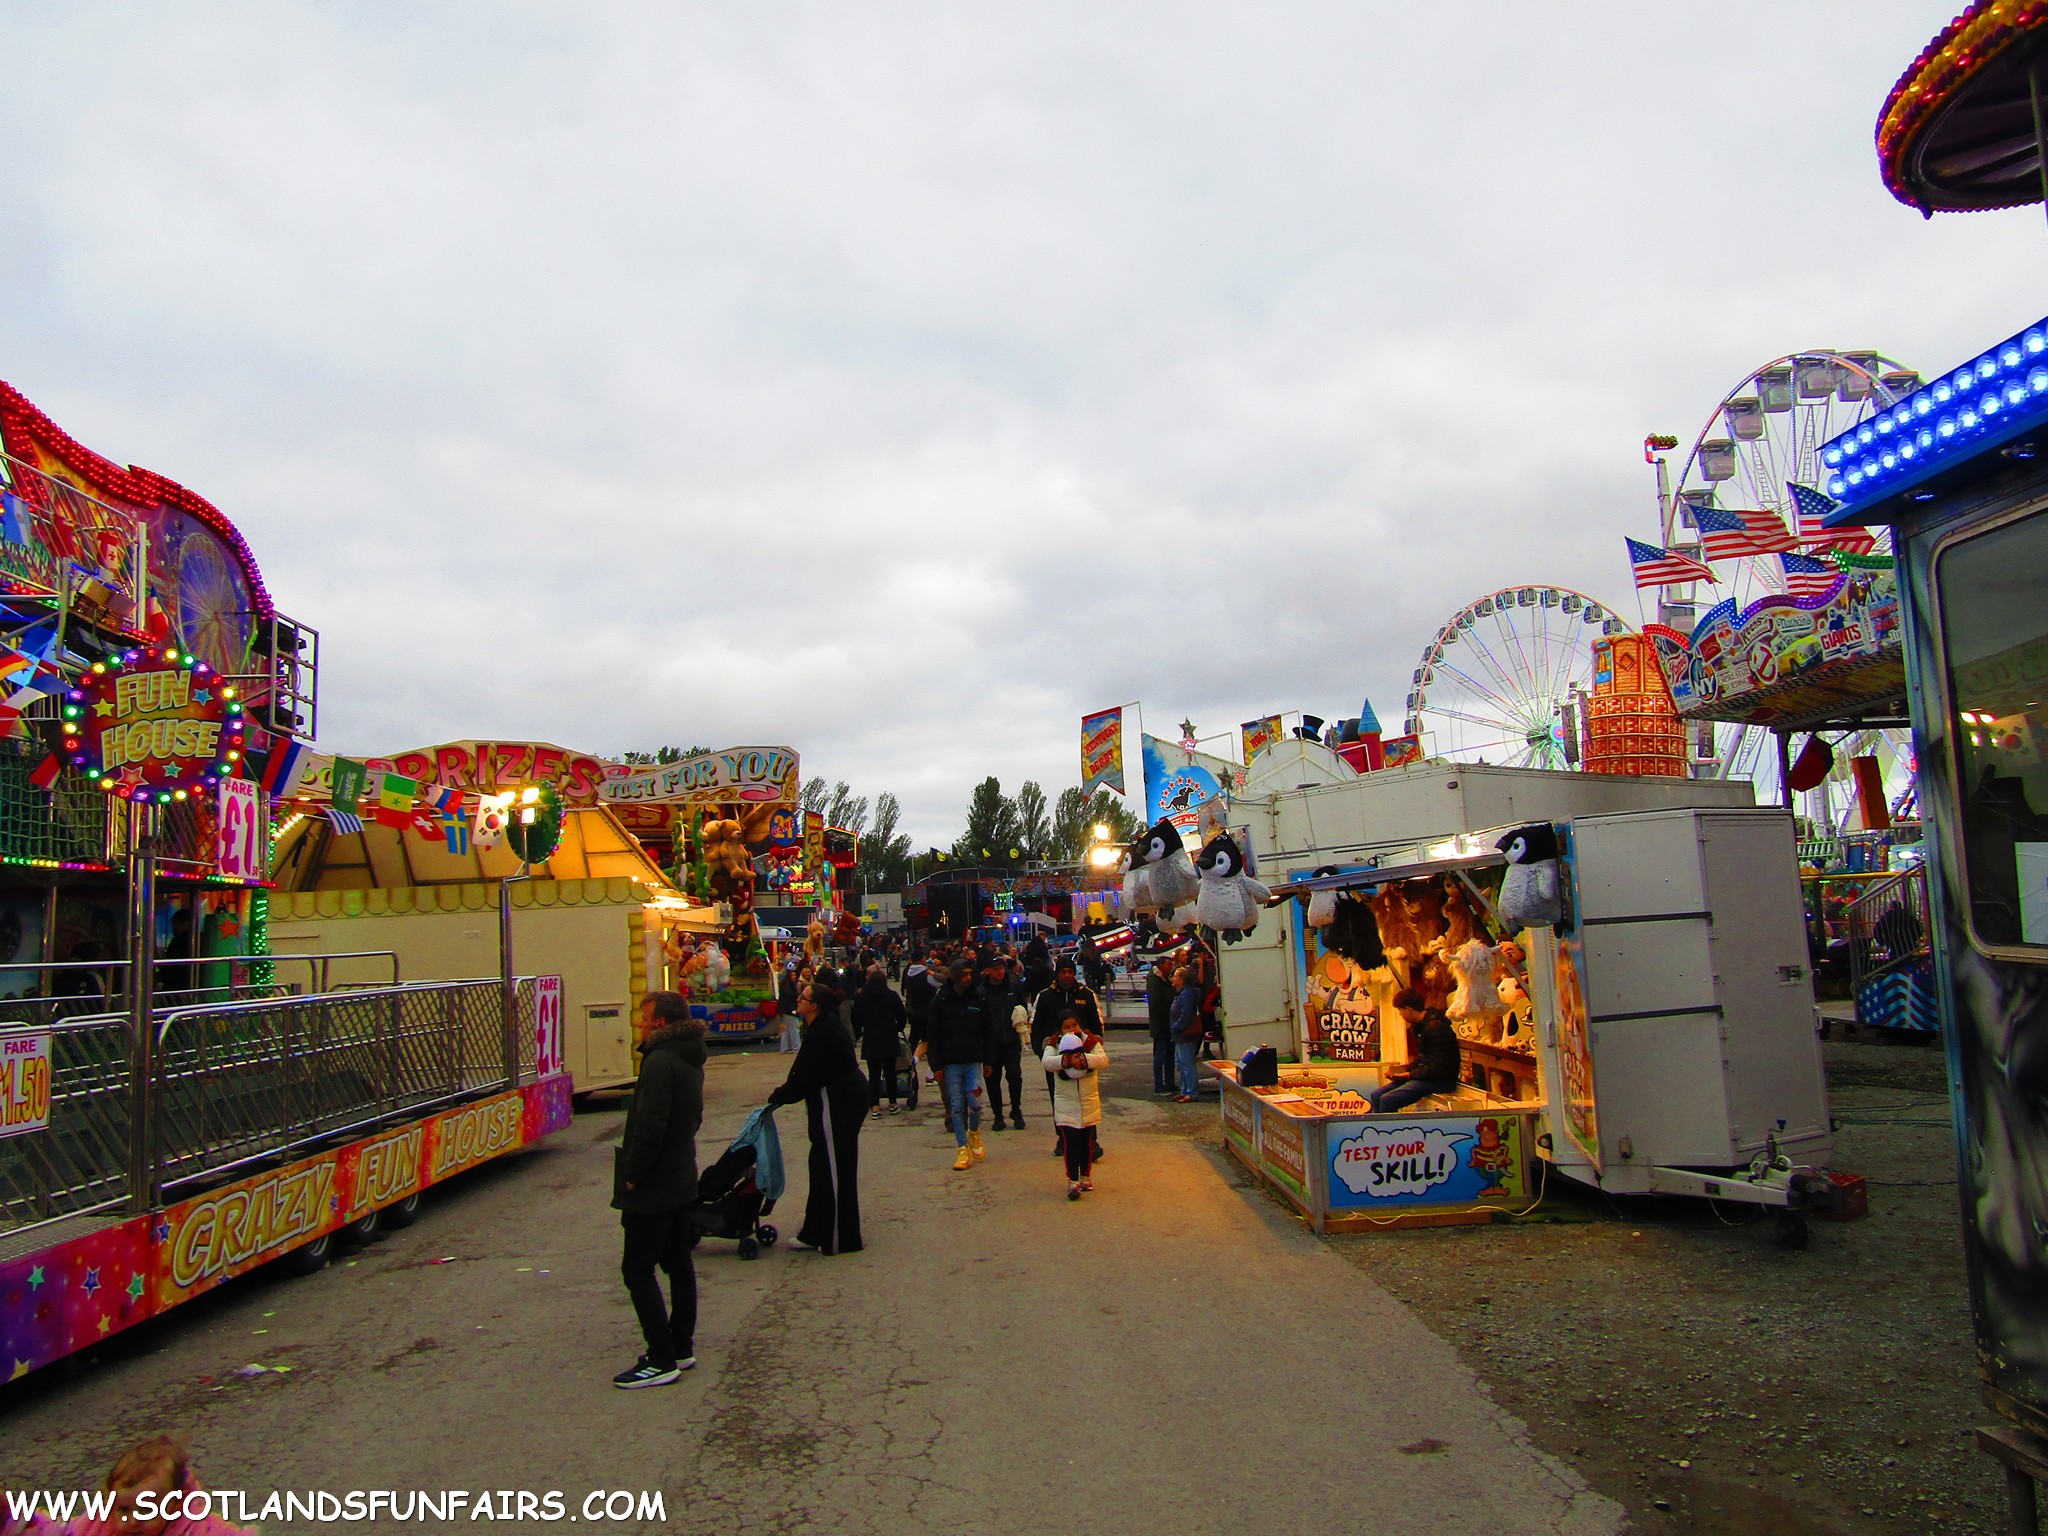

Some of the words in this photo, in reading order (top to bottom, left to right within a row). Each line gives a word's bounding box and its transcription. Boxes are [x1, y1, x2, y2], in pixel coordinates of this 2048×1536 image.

[1820, 624, 1862, 650] GIANTS
[116, 669, 191, 718] FUN
[102, 719, 222, 773] HOUSE
[394, 744, 609, 802] PRIZES
[1089, 748, 1114, 775] DERBY
[225, 780, 253, 796] FARE
[605, 778, 656, 800] JUST
[661, 759, 717, 793] FOR
[720, 750, 795, 784] YOU
[221, 795, 254, 876] £1
[771, 819, 796, 838] GAME
[540, 978, 558, 991] FARE
[536, 994, 558, 1076] £1
[719, 1022, 756, 1032] PRIZES
[1320, 1012, 1376, 1032] CRAZY
[4, 1039, 36, 1055] FARE
[1330, 1029, 1369, 1049] COW
[1335, 1048, 1364, 1060] FARM
[0, 1056, 48, 1127] 1.50
[1326, 1101, 1338, 1110] TO
[1339, 1100, 1366, 1110] ENJOY
[1344, 1146, 1380, 1162] TEST
[1386, 1141, 1425, 1158] YOUR
[1370, 1153, 1446, 1185] SKILL!
[172, 1162, 336, 1287] CRAZY
[354, 1129, 422, 1209] FUN
[437, 1096, 521, 1174] HOUSE
